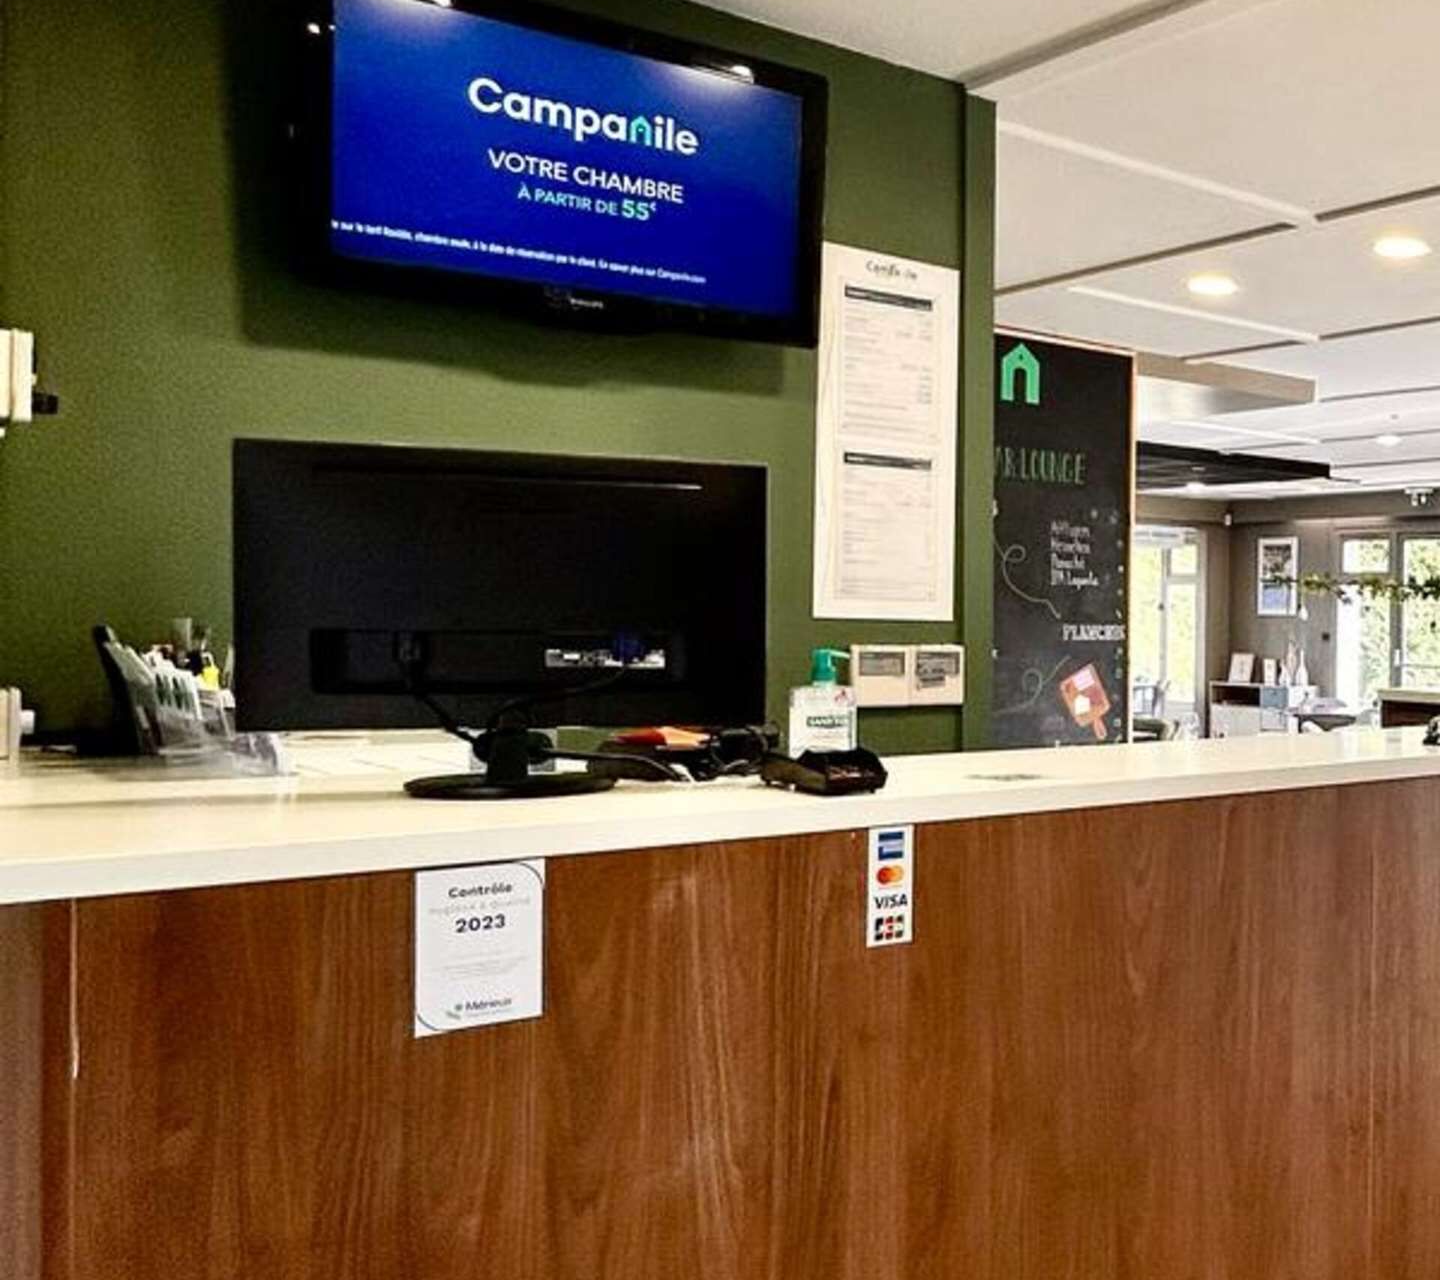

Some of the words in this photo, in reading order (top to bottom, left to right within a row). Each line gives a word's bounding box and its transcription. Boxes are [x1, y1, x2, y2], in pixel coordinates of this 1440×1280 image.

[468, 77, 699, 155] Campanile
[488, 148, 568, 182] VOTRE
[573, 166, 684, 204] CHAMBRE
[517, 182, 532, 201] À
[535, 188, 592, 212] PARTIR
[595, 200, 618, 217] DE
[1020, 448, 1086, 486] LOUNGE
[448, 881, 512, 898] Contrôle
[874, 893, 908, 909] VISA
[455, 913, 505, 934] 2023
